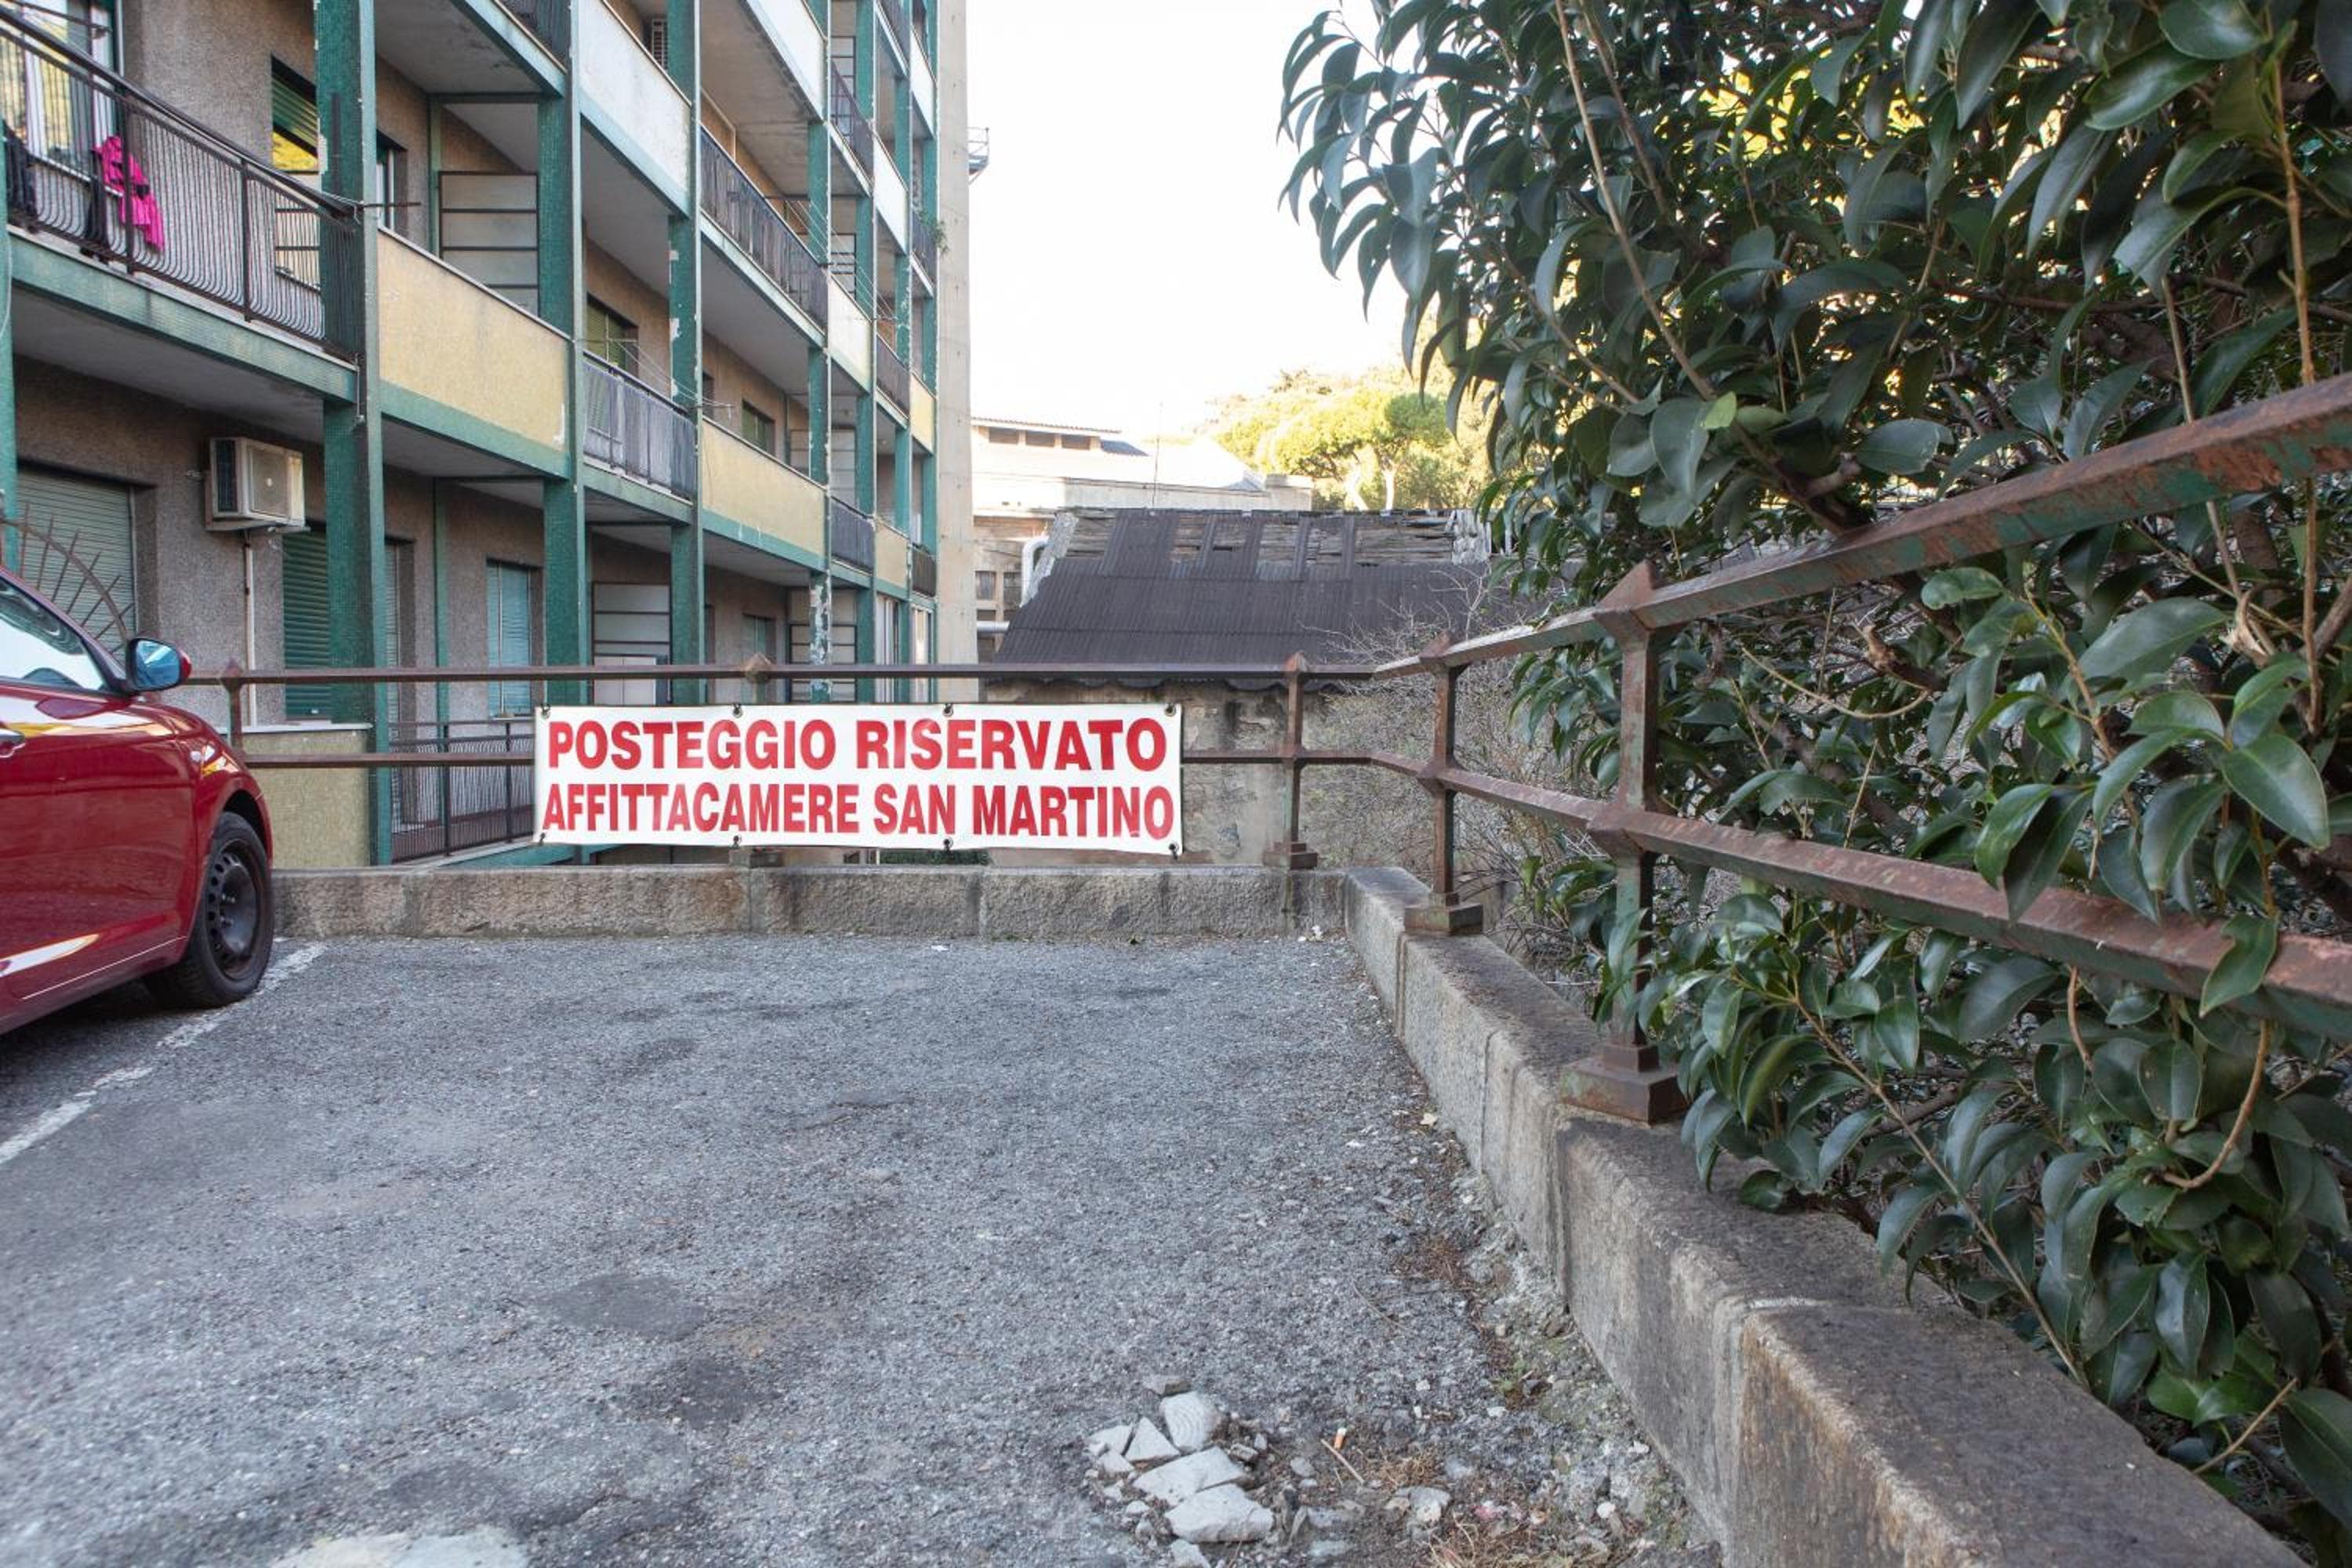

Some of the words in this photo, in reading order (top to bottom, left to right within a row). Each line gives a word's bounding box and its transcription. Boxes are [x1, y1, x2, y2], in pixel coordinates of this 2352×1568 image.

[548, 719, 836, 770] POSTEGGIO
[855, 717, 1167, 772] RISERVATO
[543, 782, 860, 834] AFFITTACAMERE
[873, 784, 956, 835] SAN
[971, 785, 1174, 840] MARTINO
